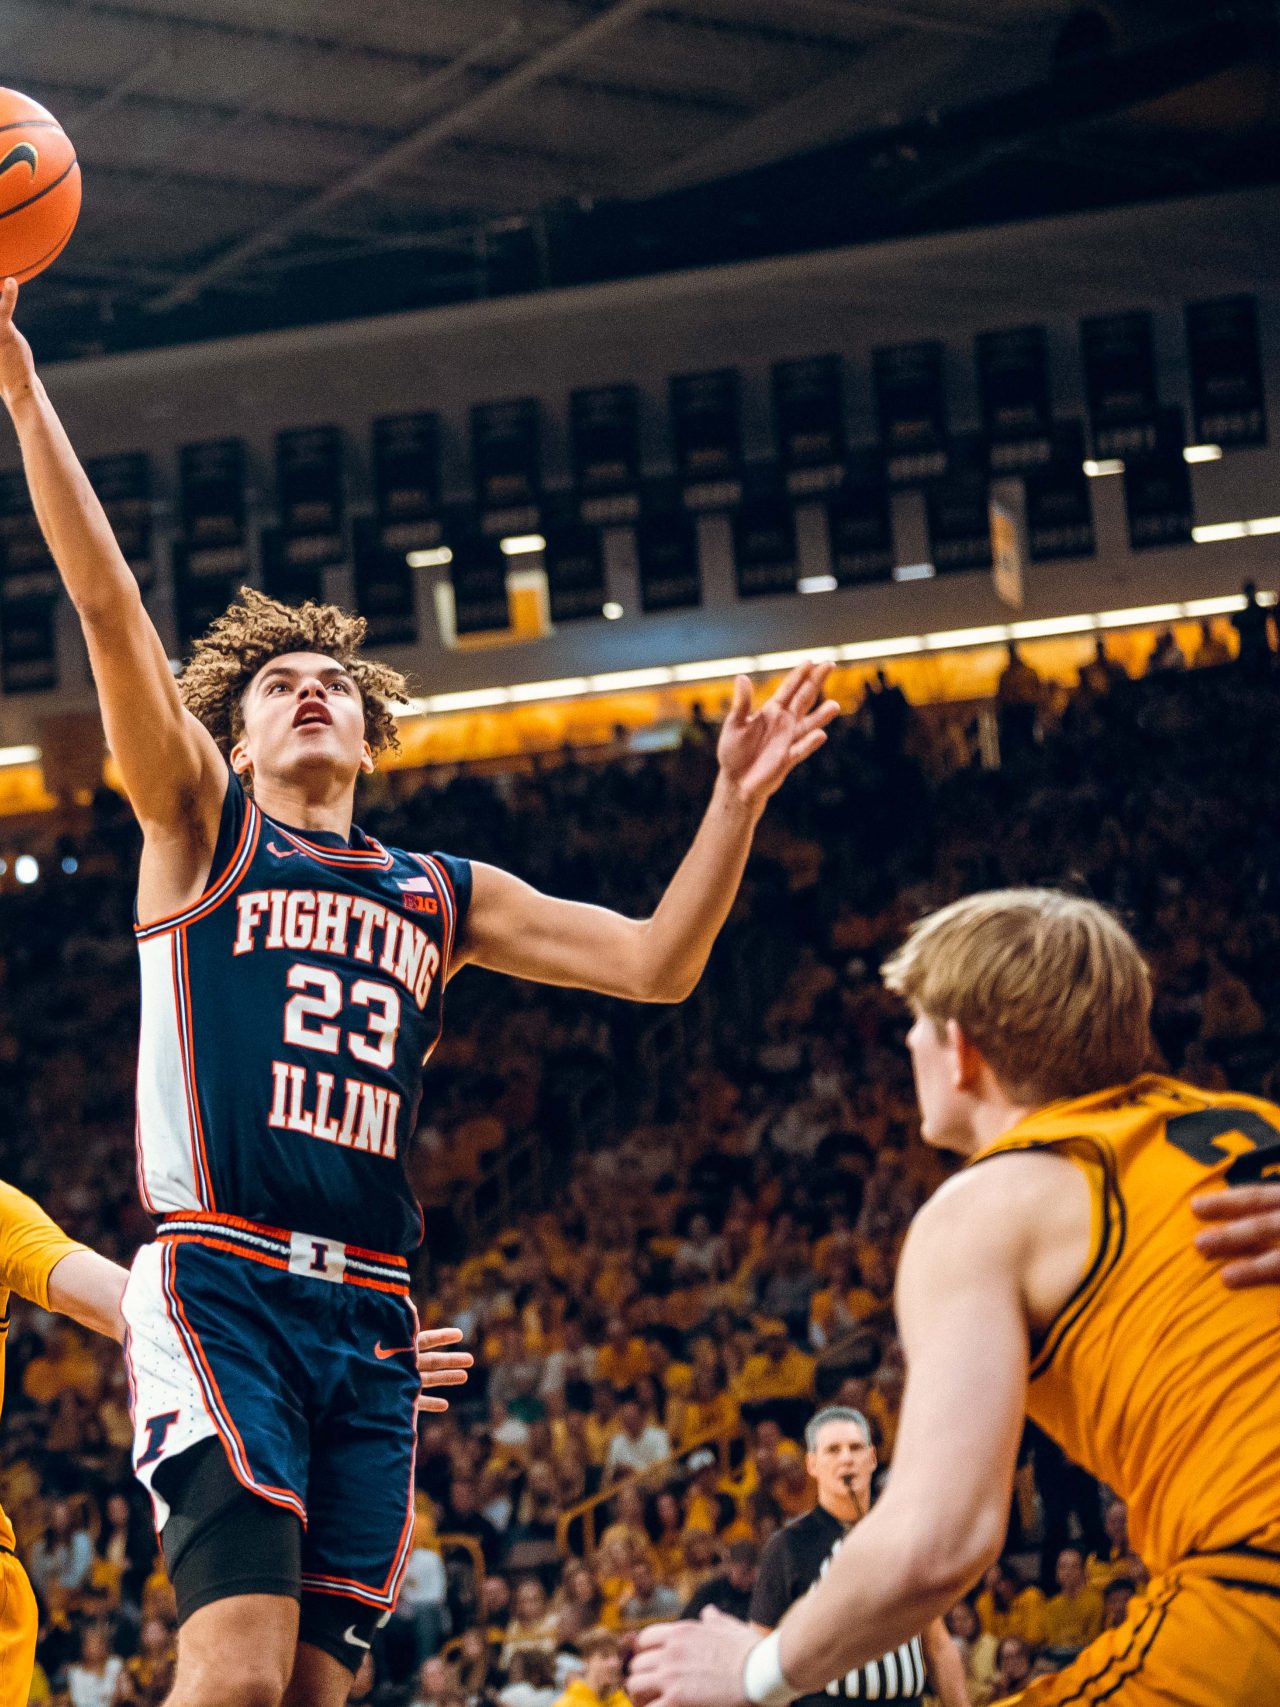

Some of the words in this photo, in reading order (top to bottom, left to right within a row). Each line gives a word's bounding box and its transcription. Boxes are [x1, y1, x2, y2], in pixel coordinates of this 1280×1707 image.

[232, 889, 441, 1011] FIGHTING
[283, 963, 401, 1070] 23
[268, 1059, 401, 1160] ILLINI
[310, 1242, 329, 1273] I
[136, 1409, 180, 1475] I
